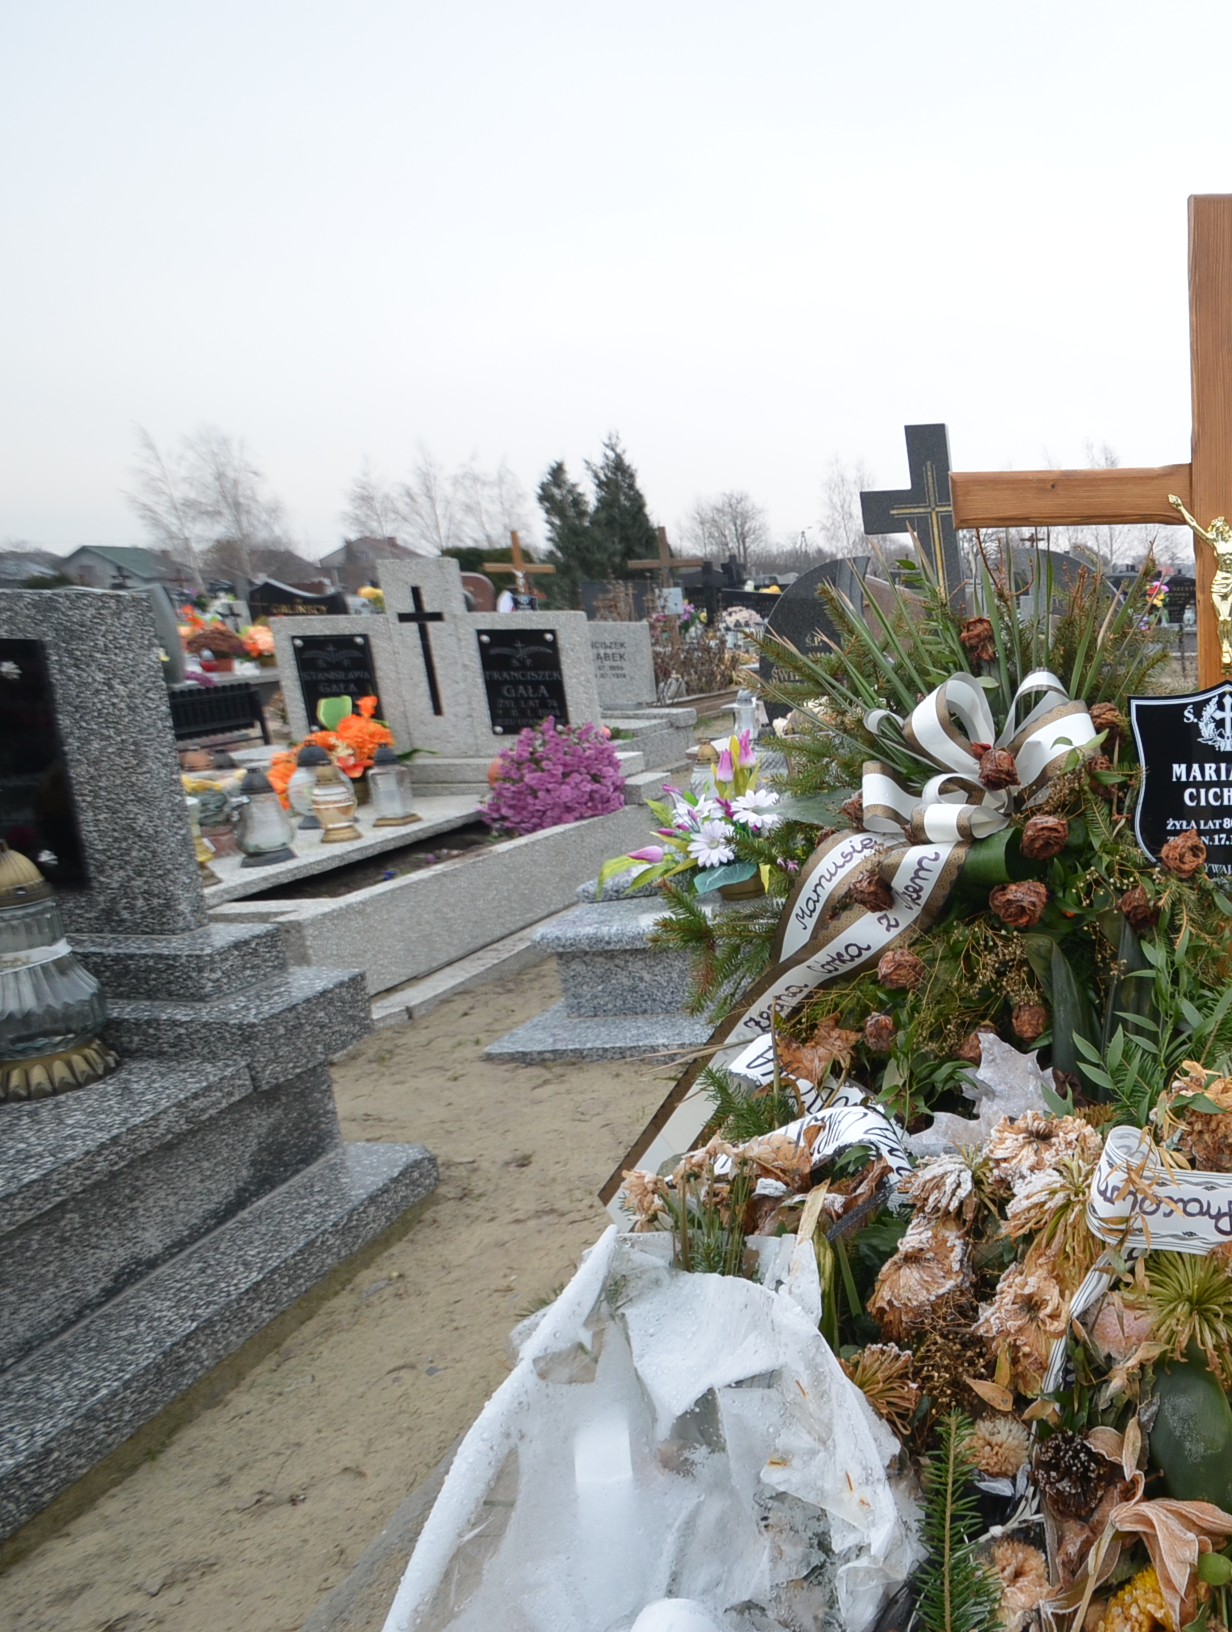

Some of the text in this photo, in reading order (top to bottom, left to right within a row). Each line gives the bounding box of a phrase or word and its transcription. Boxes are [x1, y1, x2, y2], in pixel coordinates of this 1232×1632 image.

[485, 670, 562, 681] FRANCISZEK
[1183, 704, 1198, 723] Ś.
[1166, 818, 1198, 830] ŻYŁA
[1200, 819, 1222, 830] LAT
